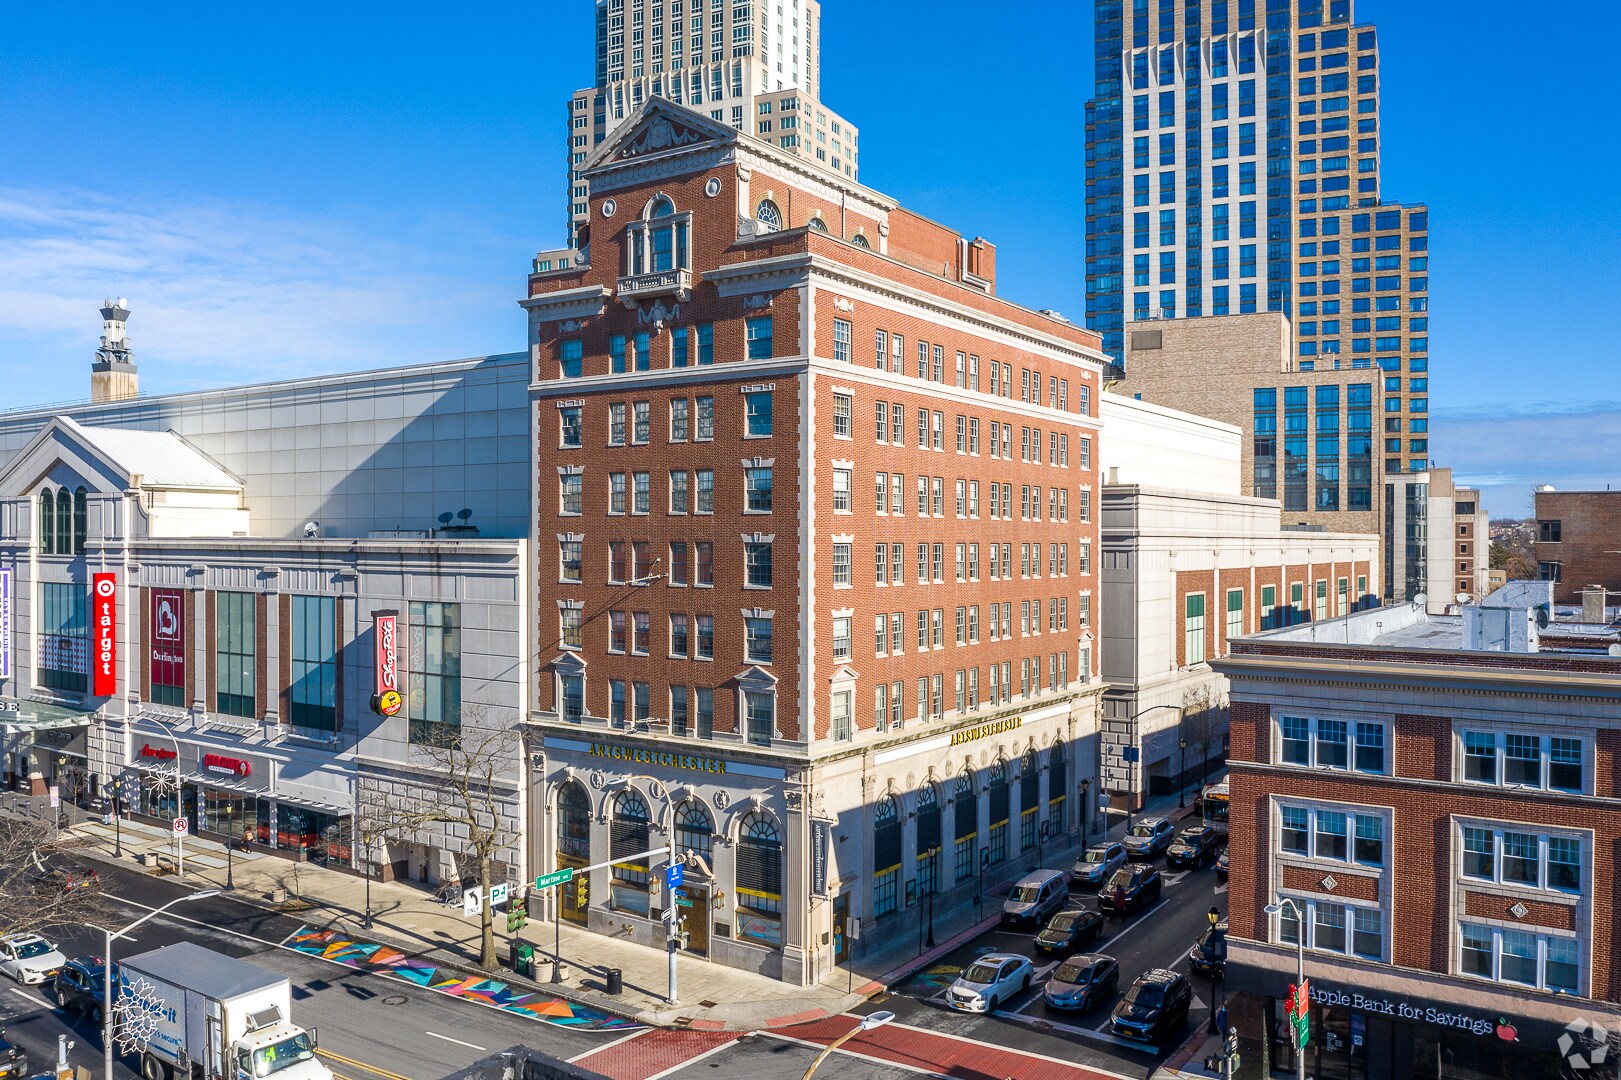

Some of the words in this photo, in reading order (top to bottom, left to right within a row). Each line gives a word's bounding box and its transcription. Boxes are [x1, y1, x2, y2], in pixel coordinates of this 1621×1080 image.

[100, 603, 112, 675] target
[381, 620, 396, 688] ShopRite
[152, 649, 183, 664] Burlington
[951, 717, 1022, 746] ARTSWESTCHESTER
[589, 743, 726, 775] ARTSWESTCHESTER
[540, 875, 561, 886] Martine
[466, 906, 480, 915] ONLY
[1308, 985, 1351, 1006] Apple
[1351, 993, 1395, 1015] Bank
[1397, 1003, 1424, 1020] for
[1425, 1007, 1493, 1035] Savings
